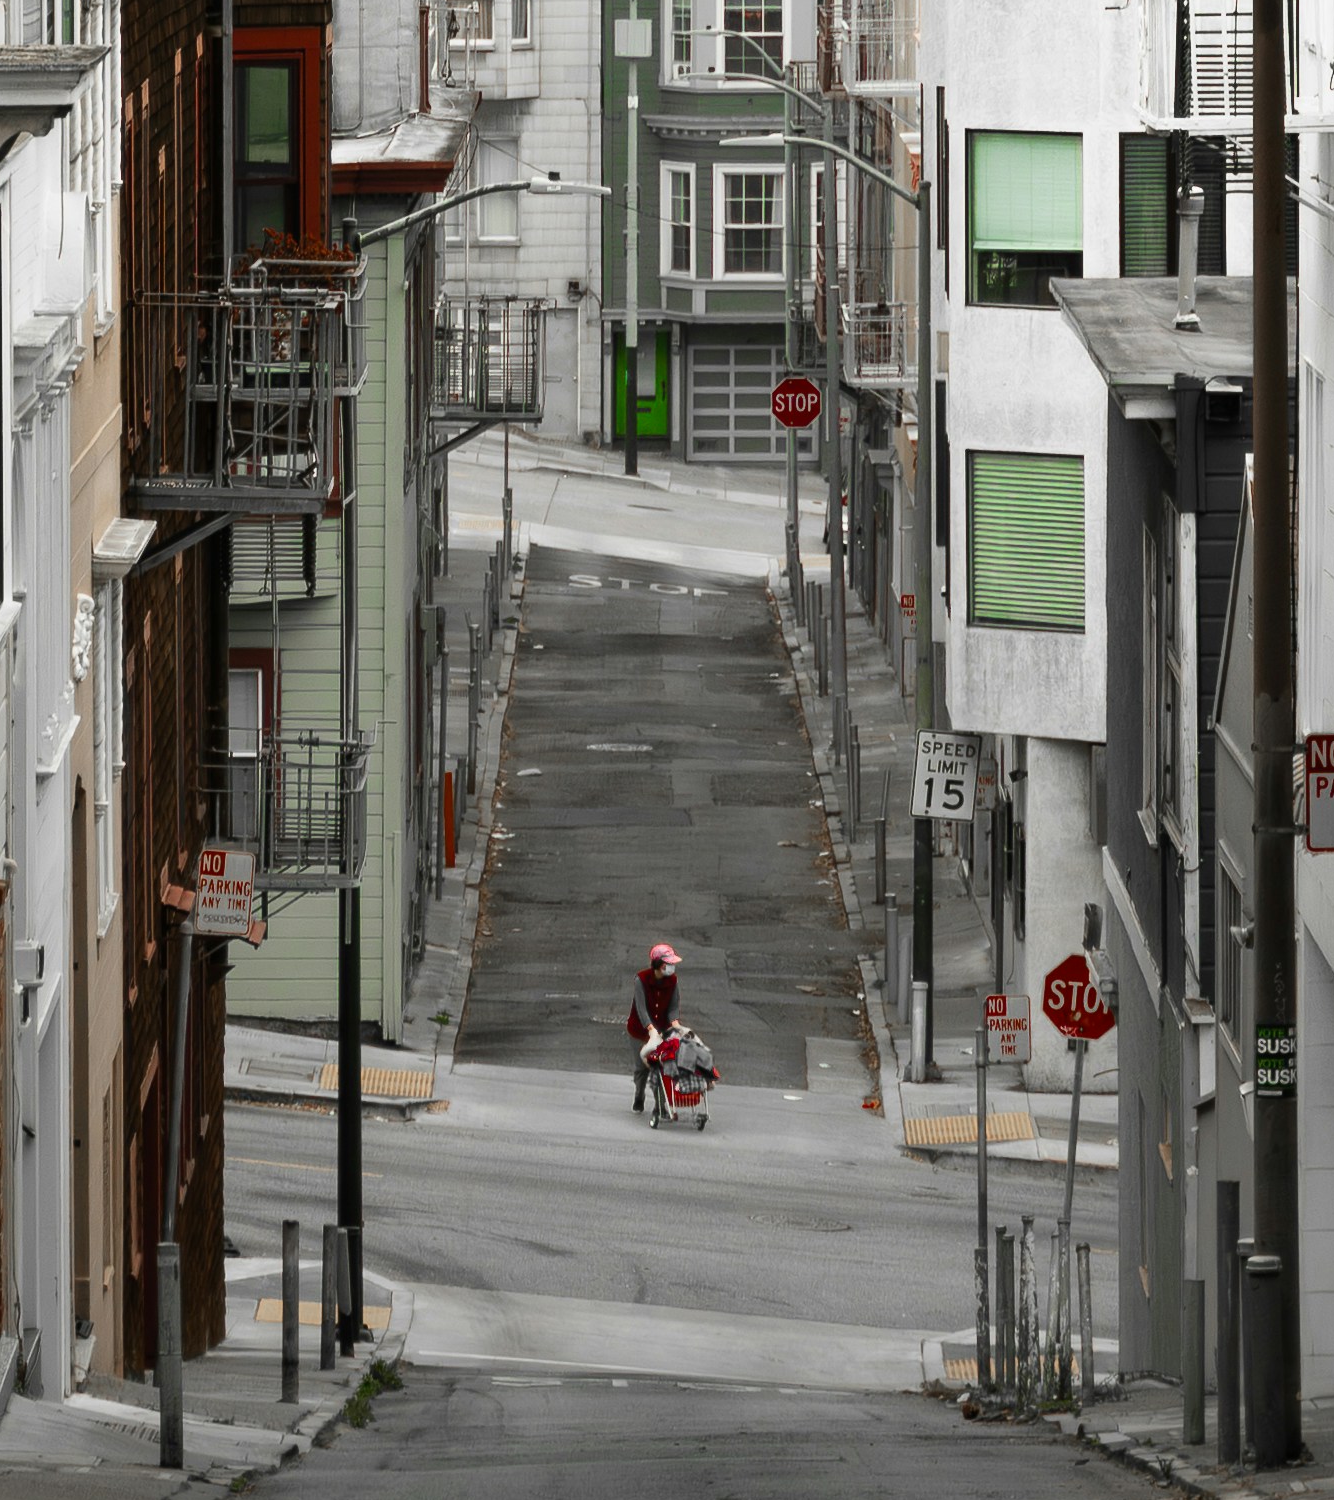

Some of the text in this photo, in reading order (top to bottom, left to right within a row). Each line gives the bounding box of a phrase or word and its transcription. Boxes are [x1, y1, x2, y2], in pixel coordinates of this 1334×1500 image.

[775, 392, 818, 413] STOP
[921, 740, 976, 758] SPEED
[927, 759, 969, 776] LIMIT
[924, 776, 965, 811] 15
[202, 853, 222, 873] NO
[200, 878, 251, 897] PARKING
[201, 896, 246, 911] ANY TIME
[988, 998, 1004, 1014] NO
[989, 1018, 1028, 1032] PARKING
[1000, 1033, 1017, 1044] ANY
[1001, 1045, 1017, 1056] TIME
